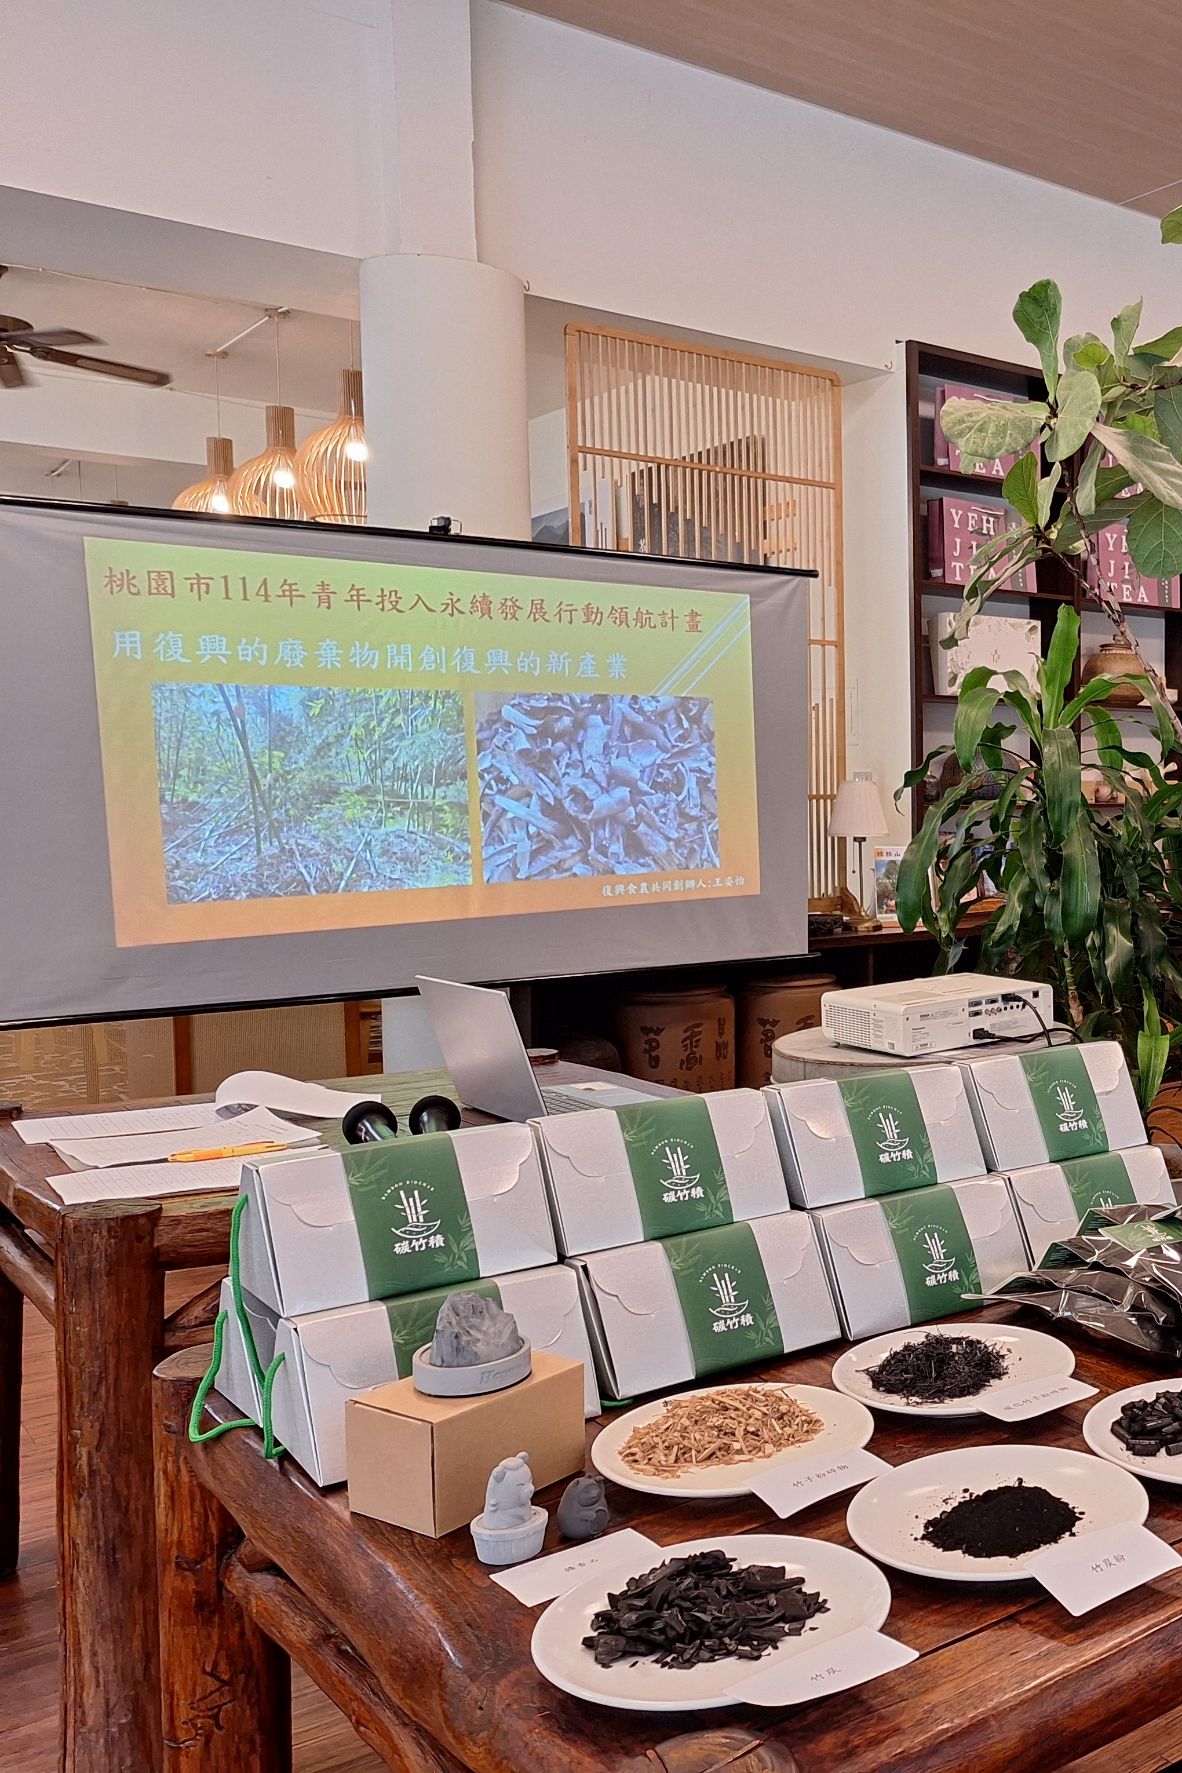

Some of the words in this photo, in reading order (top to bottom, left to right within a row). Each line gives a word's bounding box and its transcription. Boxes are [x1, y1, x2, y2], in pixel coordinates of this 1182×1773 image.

[950, 509, 995, 535] YEH
[1107, 560, 1130, 579] JI
[104, 566, 704, 633] 桃園市114年青年投入永續發展行動領航計畫
[112, 630, 628, 680] 用復興的廢棄物開創復興的新產業
[393, 1234, 445, 1254] 碳竹積
